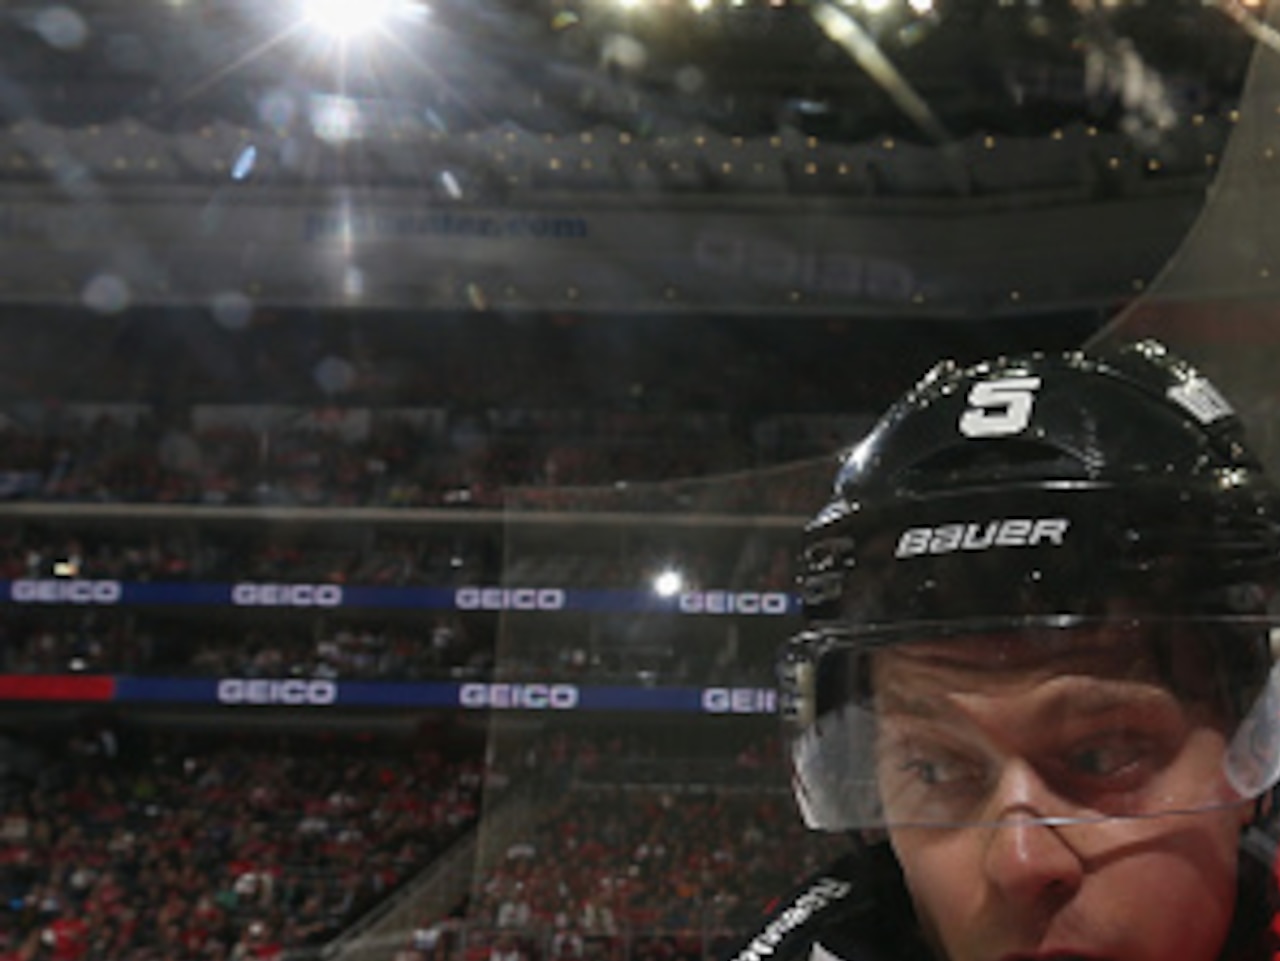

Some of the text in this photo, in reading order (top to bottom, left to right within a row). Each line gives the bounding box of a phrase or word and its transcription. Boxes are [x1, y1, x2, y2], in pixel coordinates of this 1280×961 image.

[959, 376, 1042, 438] 5
[895, 518, 1071, 559] BAUER
[12, 580, 788, 615] GEICO GEICO GEICO GEICO
[218, 679, 777, 713] GEICO GEICO GEI
